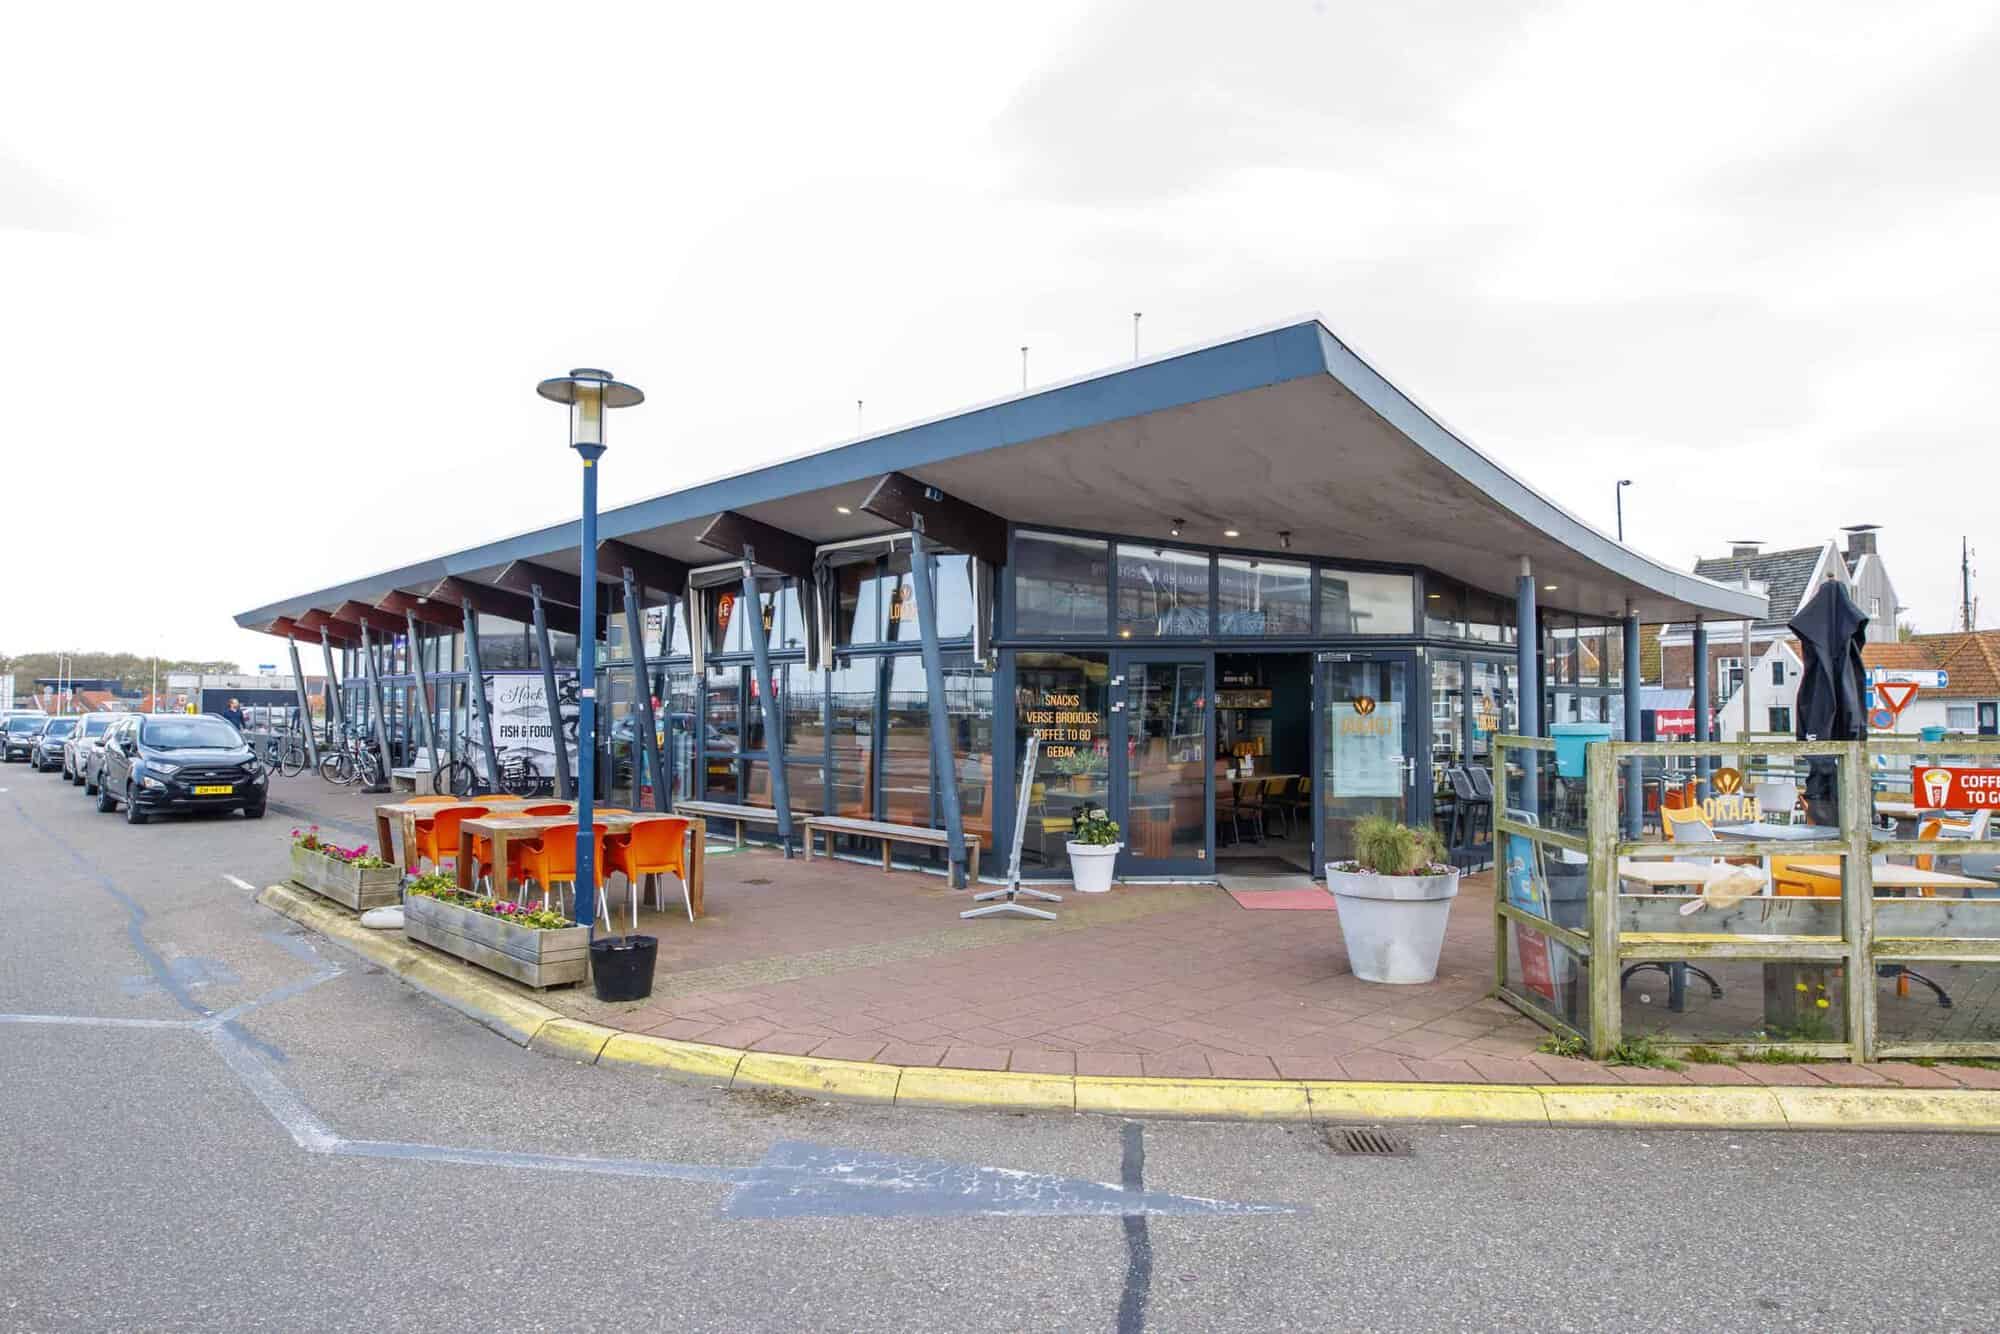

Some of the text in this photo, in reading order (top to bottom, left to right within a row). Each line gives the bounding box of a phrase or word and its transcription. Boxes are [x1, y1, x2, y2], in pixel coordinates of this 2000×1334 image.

[1045, 694, 1080, 706] SNACKS
[1026, 711, 1098, 724] VERSE BROODJES
[500, 725, 552, 738] FISH & FOOD
[1067, 728, 1078, 741] TO
[1079, 728, 1091, 741] GO
[1047, 745, 1076, 758] GEBAK
[1966, 791, 2000, 804] TO G
